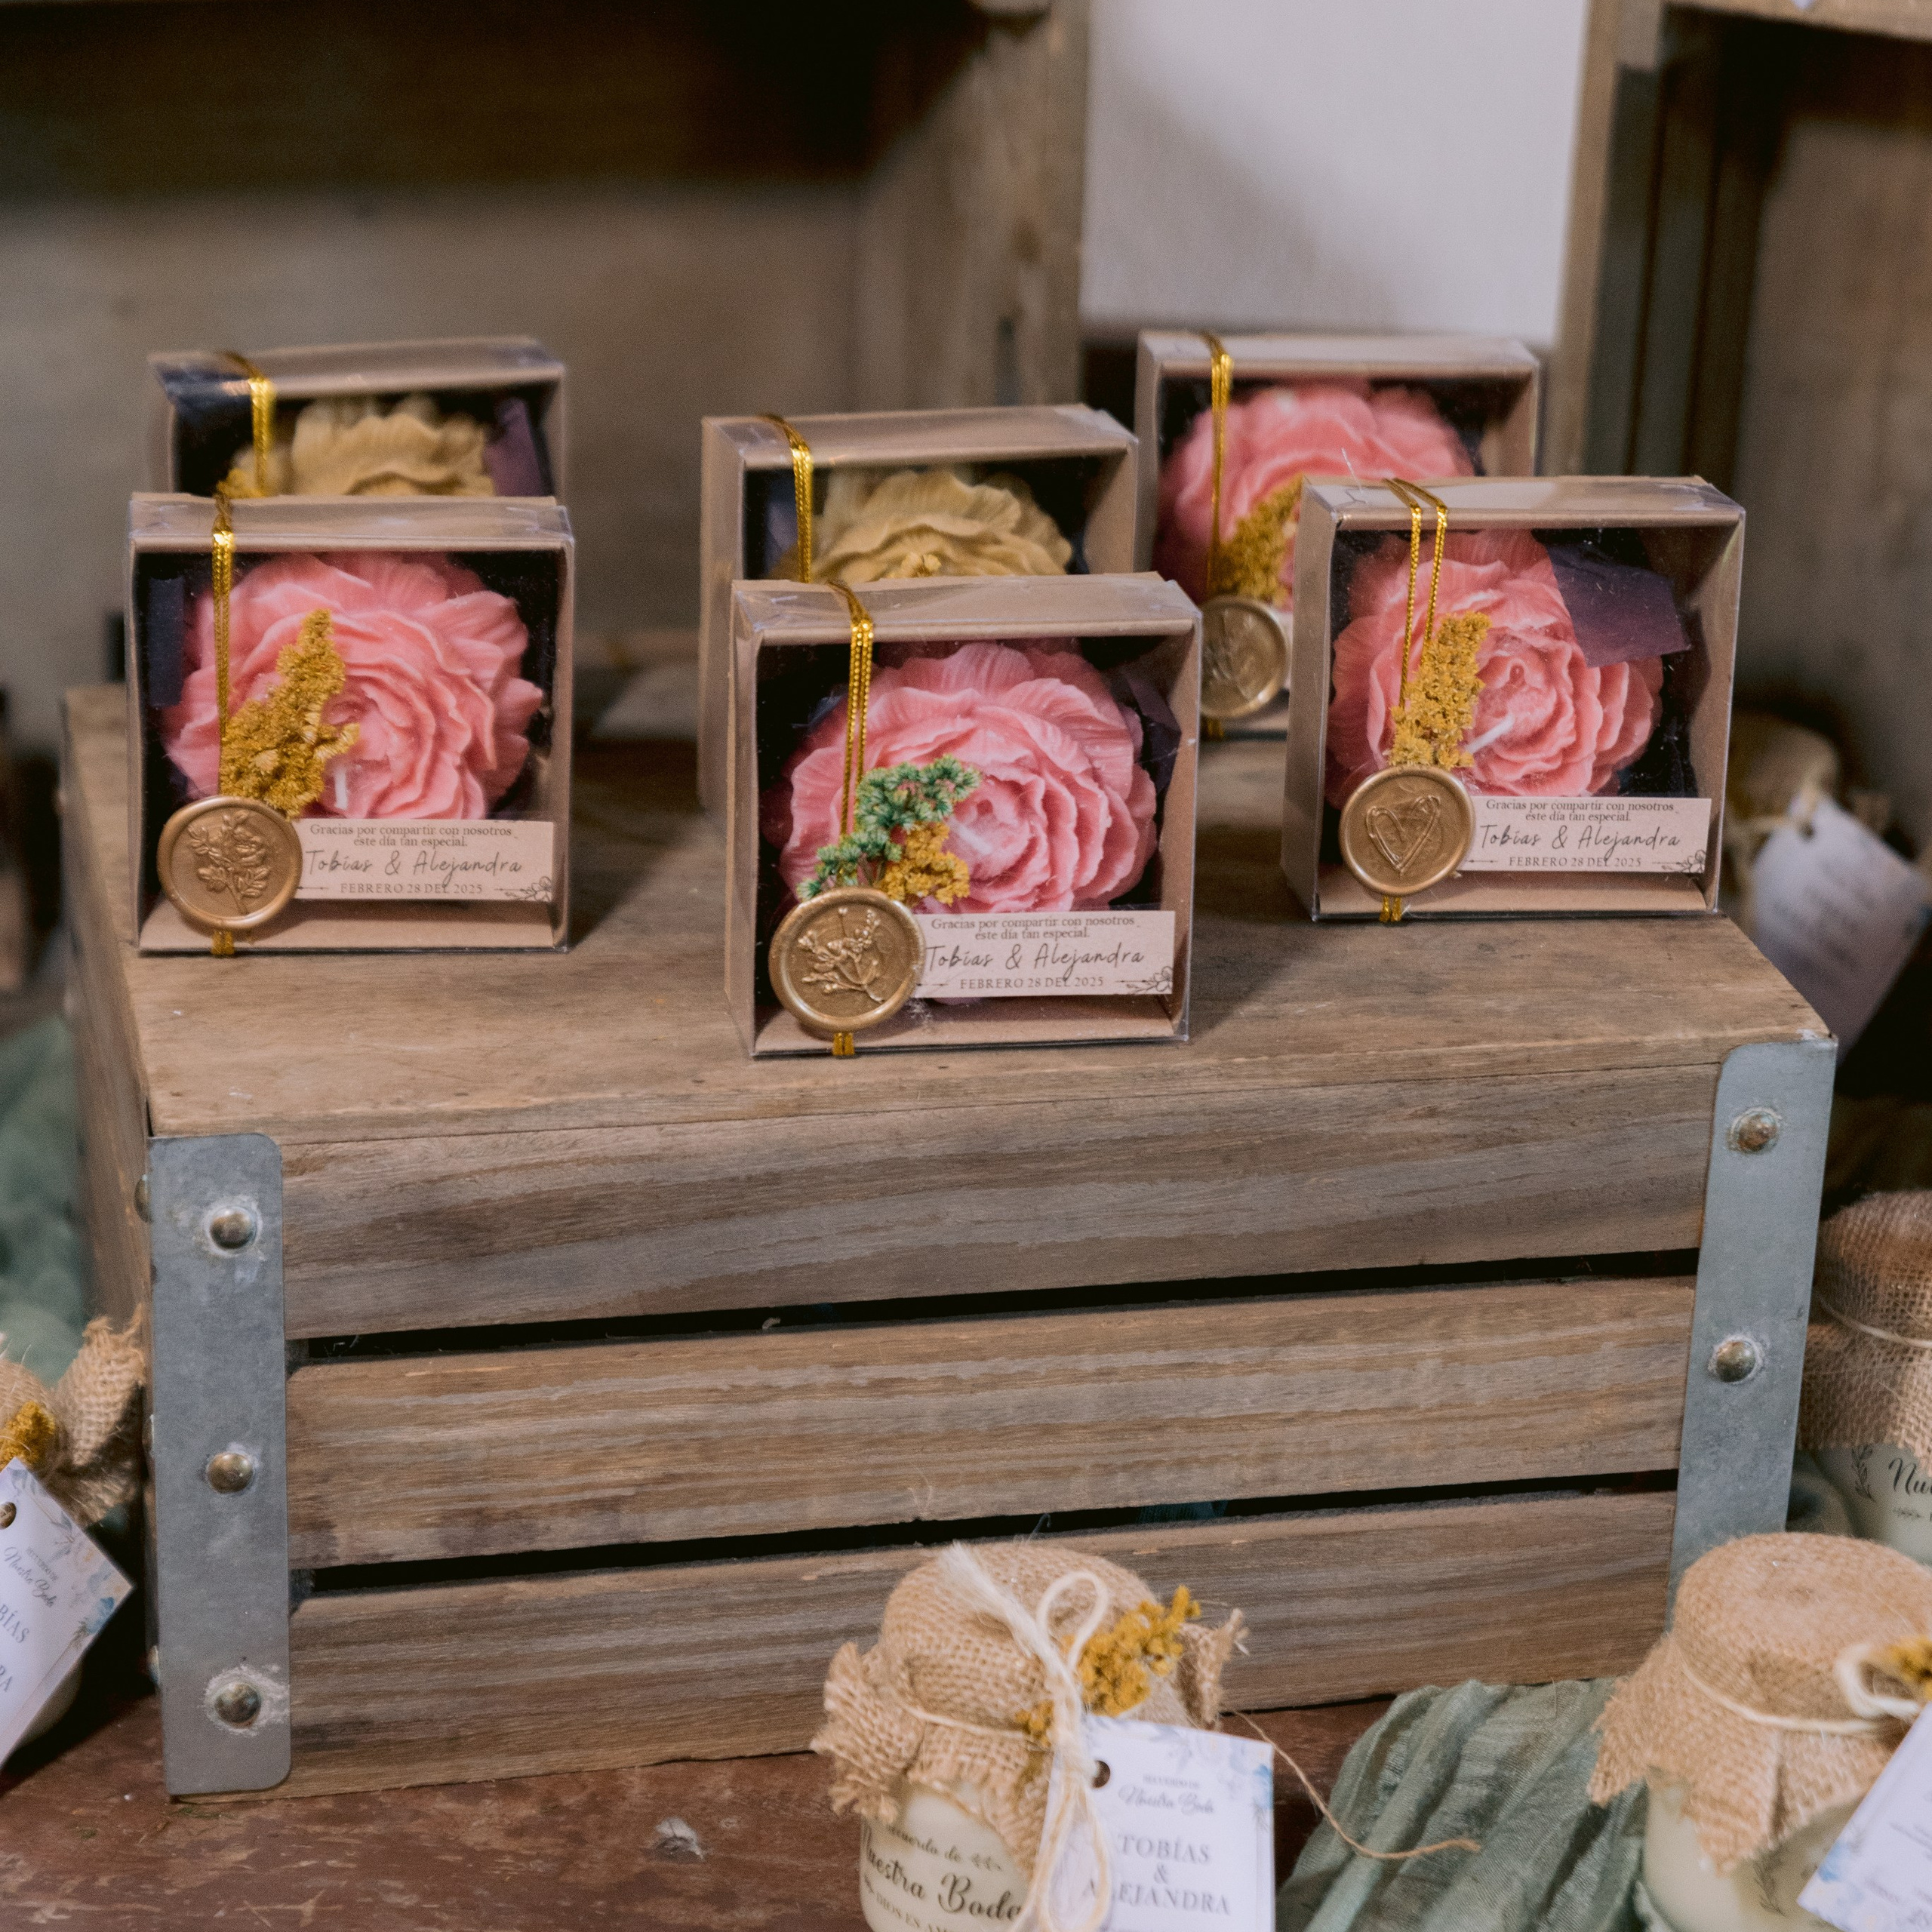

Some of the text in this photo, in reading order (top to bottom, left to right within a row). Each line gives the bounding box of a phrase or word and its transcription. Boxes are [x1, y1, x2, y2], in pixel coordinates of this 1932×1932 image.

[1486, 799, 1527, 810] Gracias
[1530, 802, 1548, 813] por
[1551, 800, 1603, 813] compartir
[1628, 803, 1674, 811] nosotros
[310, 823, 353, 835] Gracias
[357, 827, 376, 837] por
[380, 824, 435, 838] compartir
[463, 827, 512, 835] nosotros
[1552, 825, 1567, 850] &
[1577, 825, 1681, 861] Alejandra
[384, 850, 401, 875] &
[413, 850, 522, 888] Alejandra
[1509, 857, 1641, 867] FEBRERO 28 DEL 2025
[340, 883, 483, 894] FEBRERO 28 DEL 2025
[931, 918, 975, 930] Gracias
[979, 920, 997, 931] por
[1001, 916, 1058, 931] compartir
[1086, 916, 1134, 925] nosotros
[975, 931, 997, 940] este
[1022, 930, 1039, 939] tan
[1005, 943, 1023, 970] &
[1034, 942, 1145, 982] Alejandra
[960, 976, 1103, 989] FEBRERO 28 DEL 2025
[1118, 1834, 1211, 1865] TOBÍAS
[1153, 1862, 1169, 1885] &
[1082, 1878, 1232, 1916] AEJANDRA
